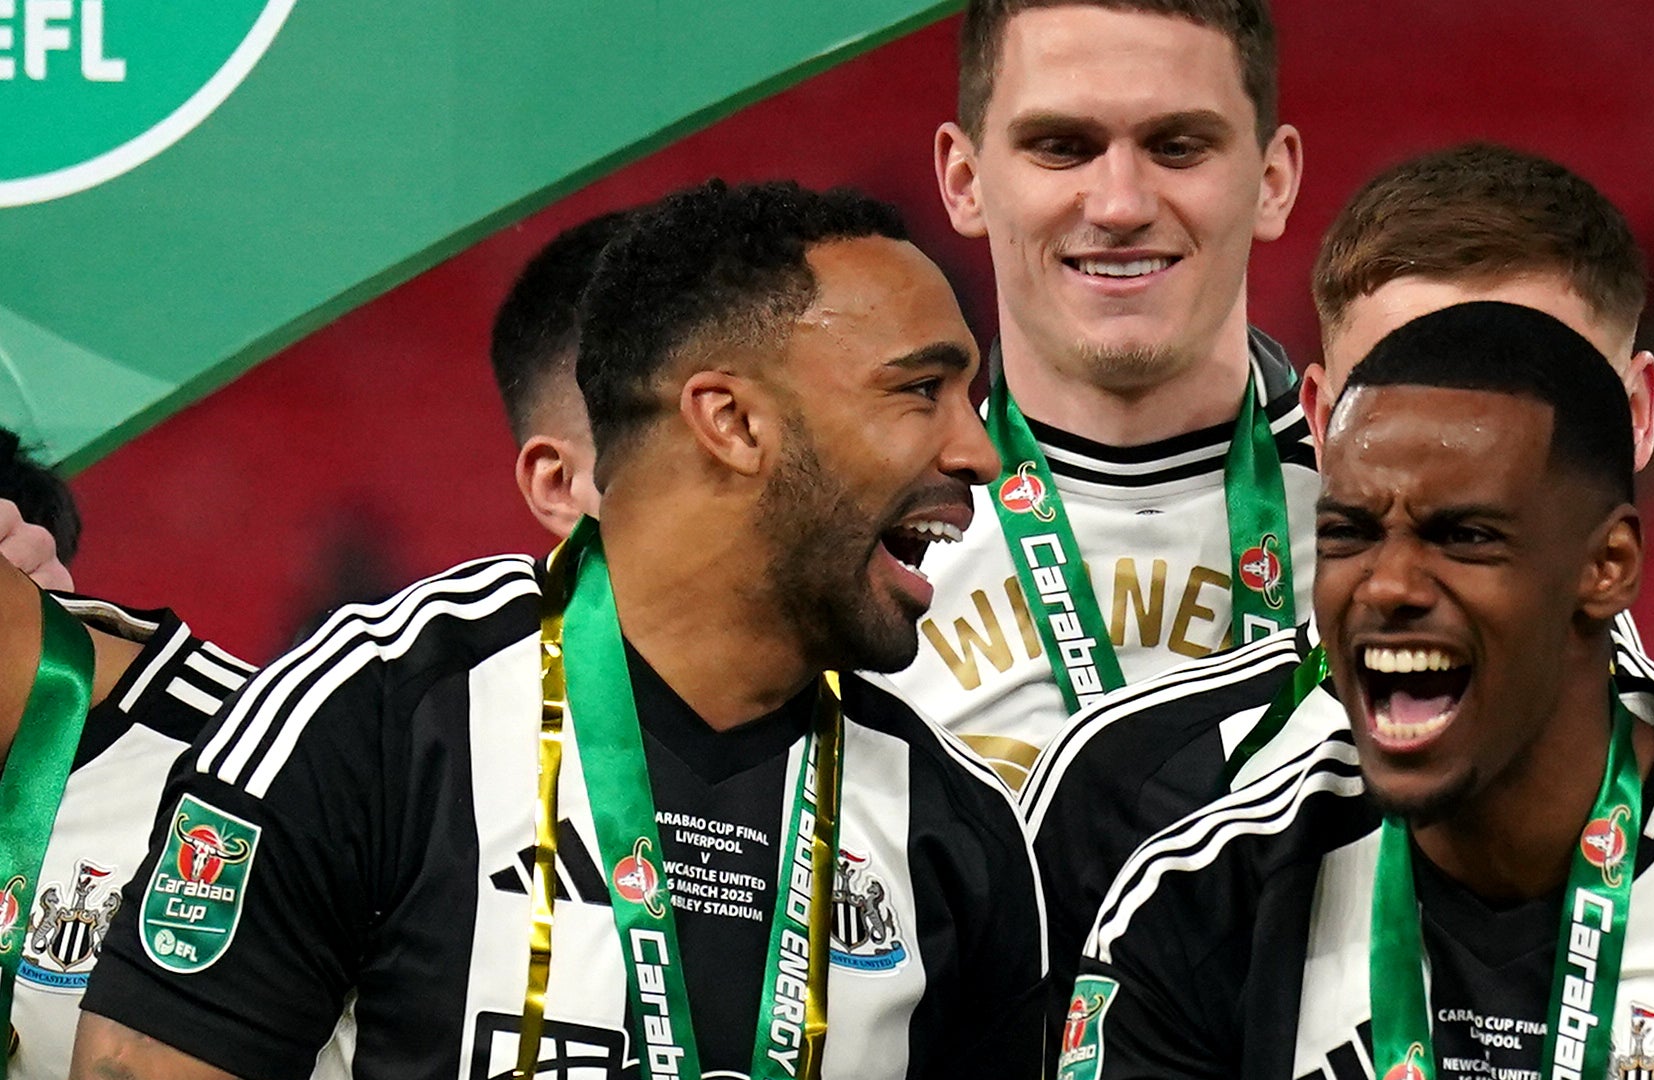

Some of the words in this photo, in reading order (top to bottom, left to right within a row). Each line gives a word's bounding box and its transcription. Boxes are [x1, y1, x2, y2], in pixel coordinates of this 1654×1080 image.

[1019, 533, 1106, 711] Caraba
[655, 811, 706, 830] ARABAO
[707, 820, 734, 836] CUP
[736, 826, 769, 846] FINAL
[675, 829, 743, 854] LIVERPOOL
[700, 851, 711, 864] V
[154, 873, 236, 902] Carabao
[662, 861, 717, 882] WCASTLE
[719, 871, 766, 891] UNITED
[676, 879, 718, 898] MARCH
[720, 888, 753, 903] 2025
[165, 898, 207, 923] Cup
[703, 901, 763, 922] STADIUM
[174, 941, 199, 962] EFL
[767, 928, 812, 1077] ENERGY
[1485, 1016, 1515, 1031] CUP
[1515, 1020, 1549, 1035] FINA
